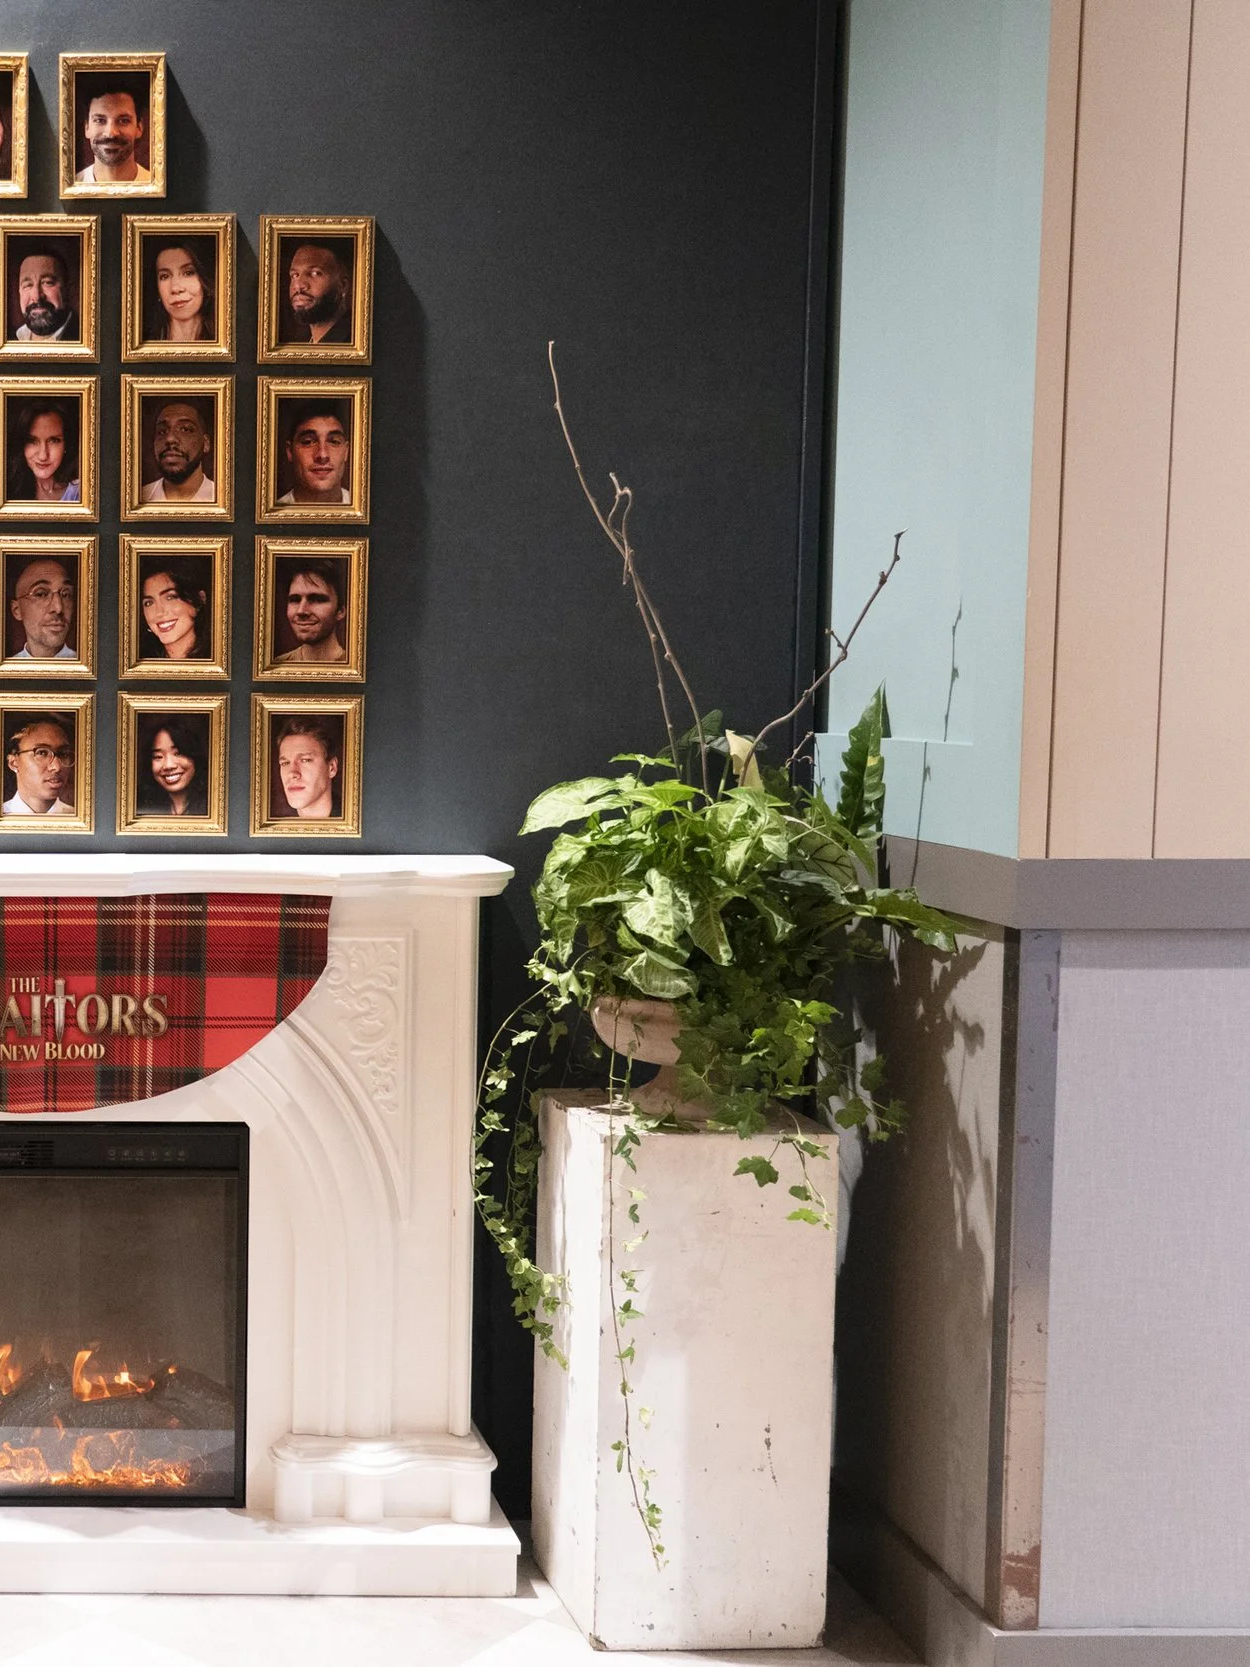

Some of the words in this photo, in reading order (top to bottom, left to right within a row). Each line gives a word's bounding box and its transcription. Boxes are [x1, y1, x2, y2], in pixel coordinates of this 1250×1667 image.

[9, 977, 40, 993] THE
[0, 1044, 40, 1061] NEW
[45, 1042, 105, 1060] BLOOD
